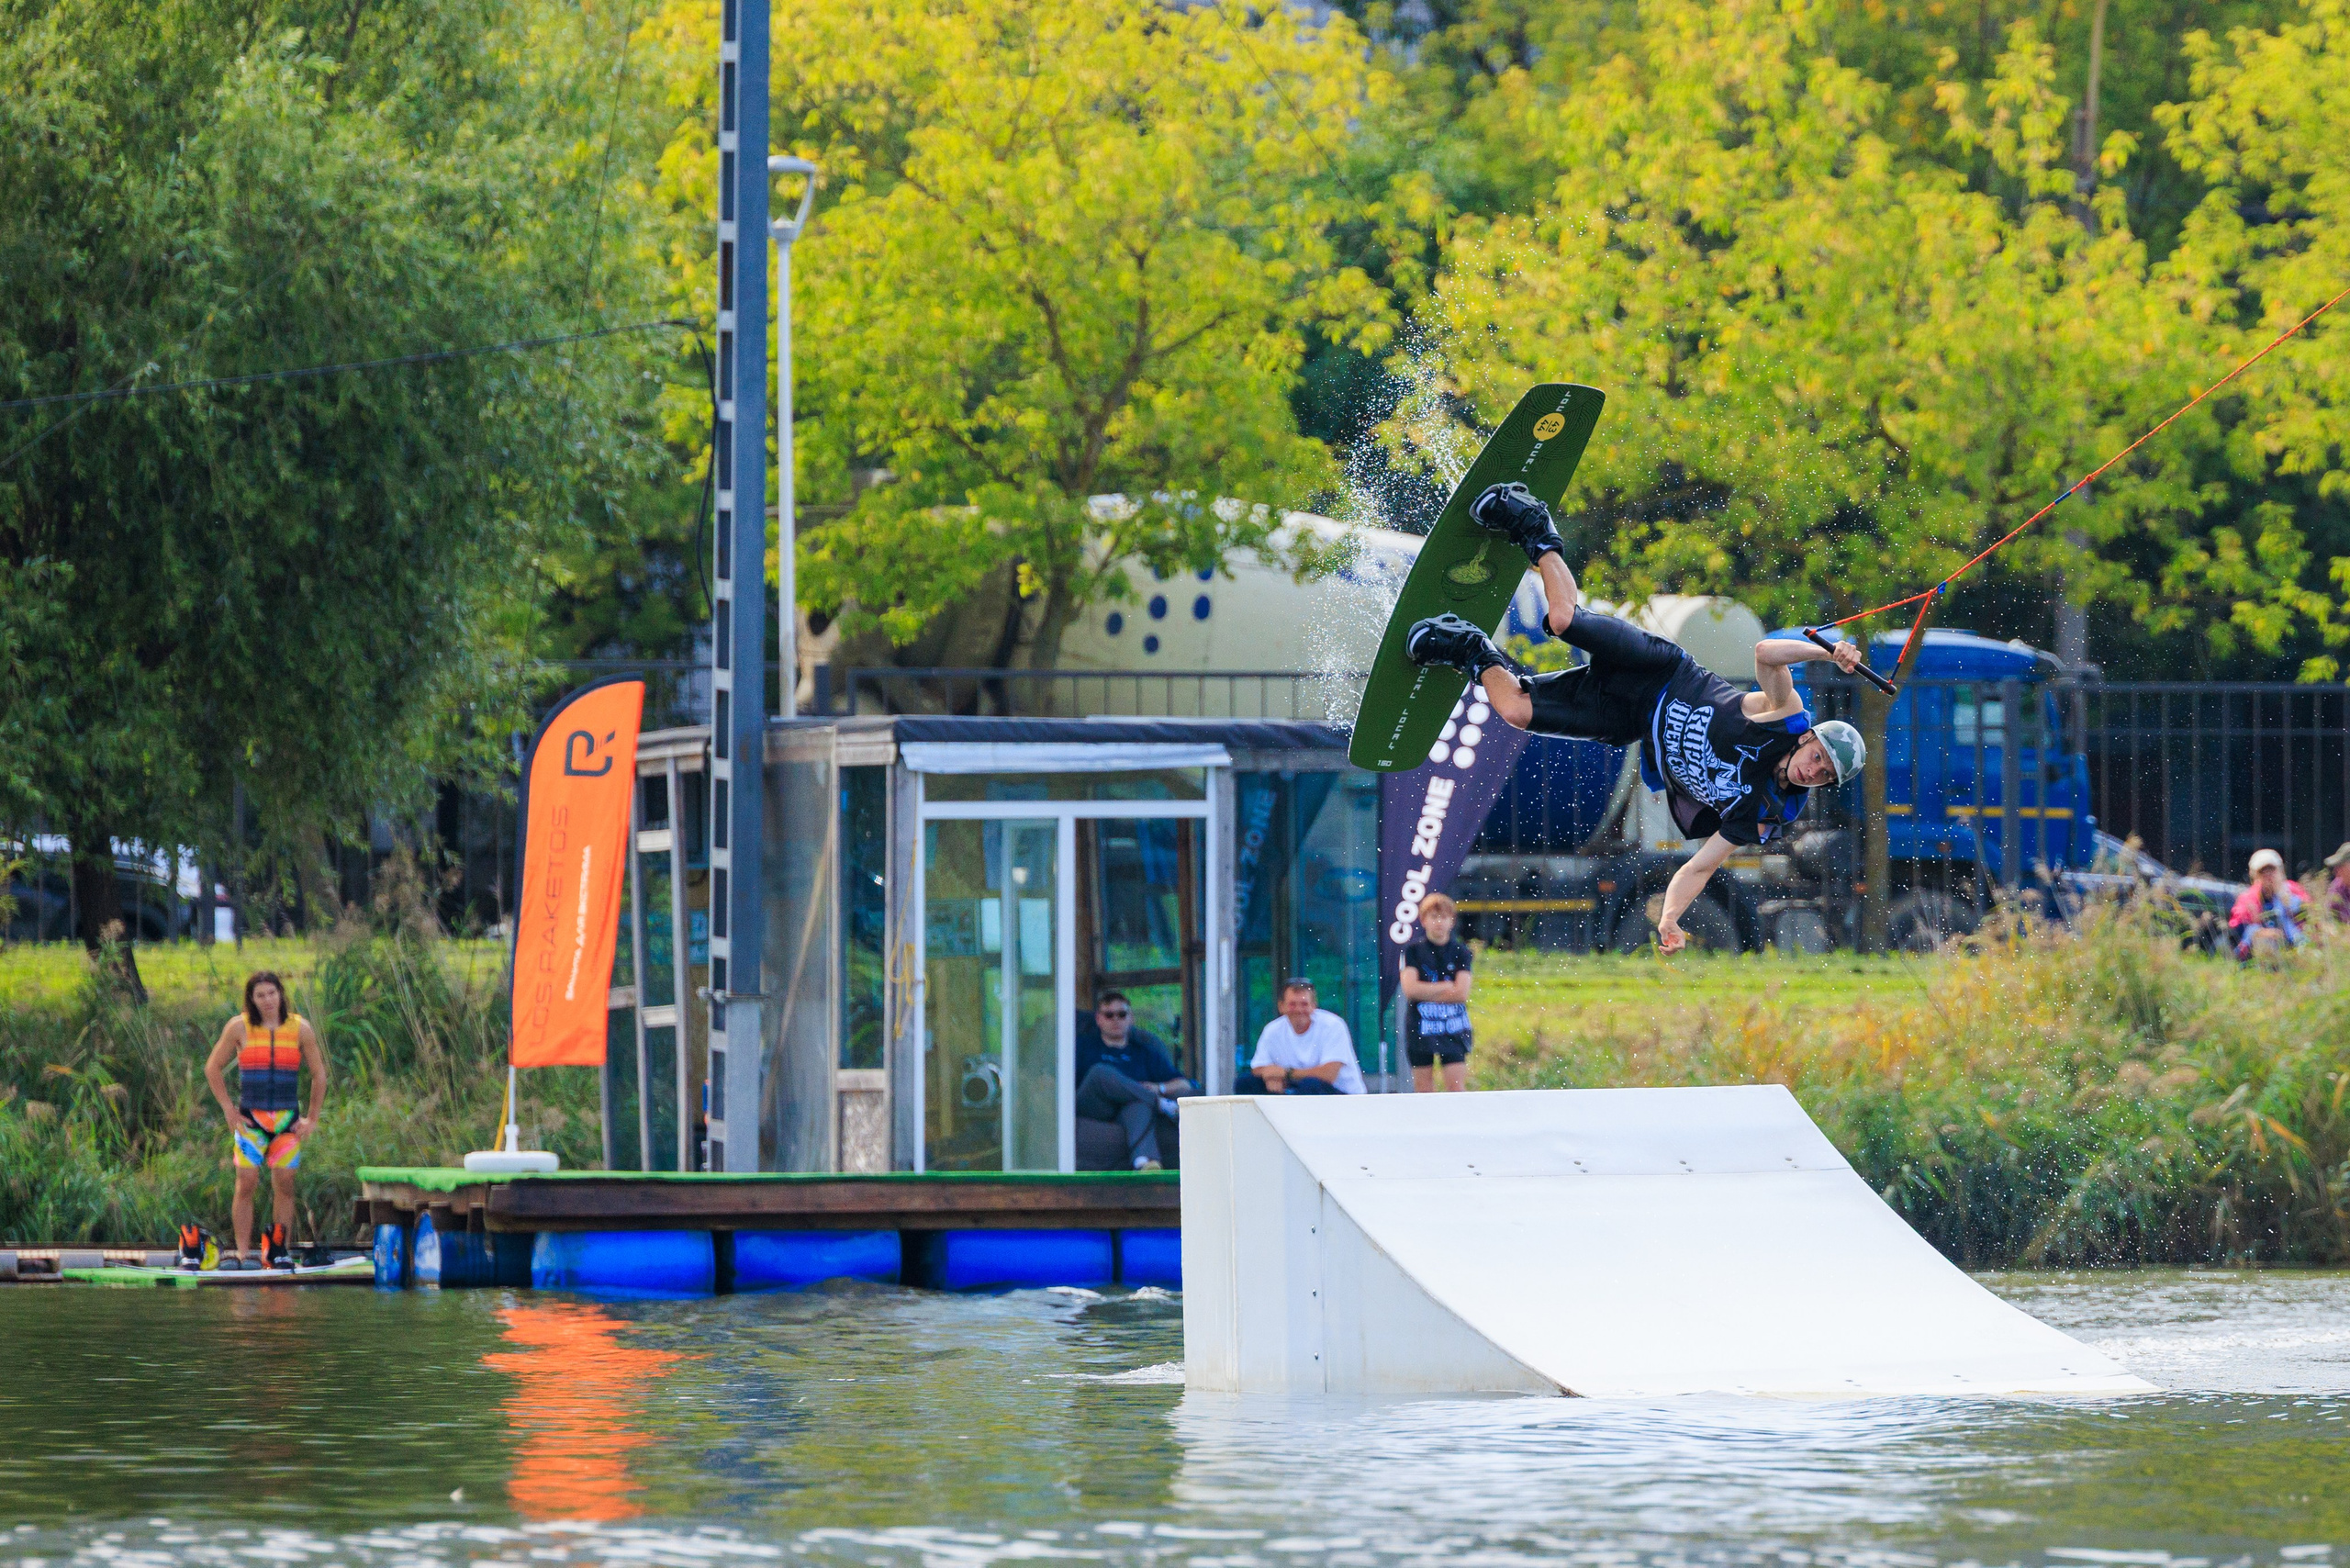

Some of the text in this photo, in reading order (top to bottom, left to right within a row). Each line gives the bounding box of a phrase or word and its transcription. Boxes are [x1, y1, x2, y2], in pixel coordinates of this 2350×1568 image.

[1521, 390, 1572, 472] LOC OCAL
[1537, 419, 1550, 432] 44
[1548, 420, 1561, 433] 43
[1388, 667, 1428, 750] OCAL LOCAL
[1666, 705, 1700, 801] OPEN CONT
[1239, 788, 1277, 866] ZONE
[1389, 776, 1455, 944] COOL ZONE
[529, 804, 568, 1047] LOS RAKETOS
[575, 915, 587, 948] ДЛЯ
